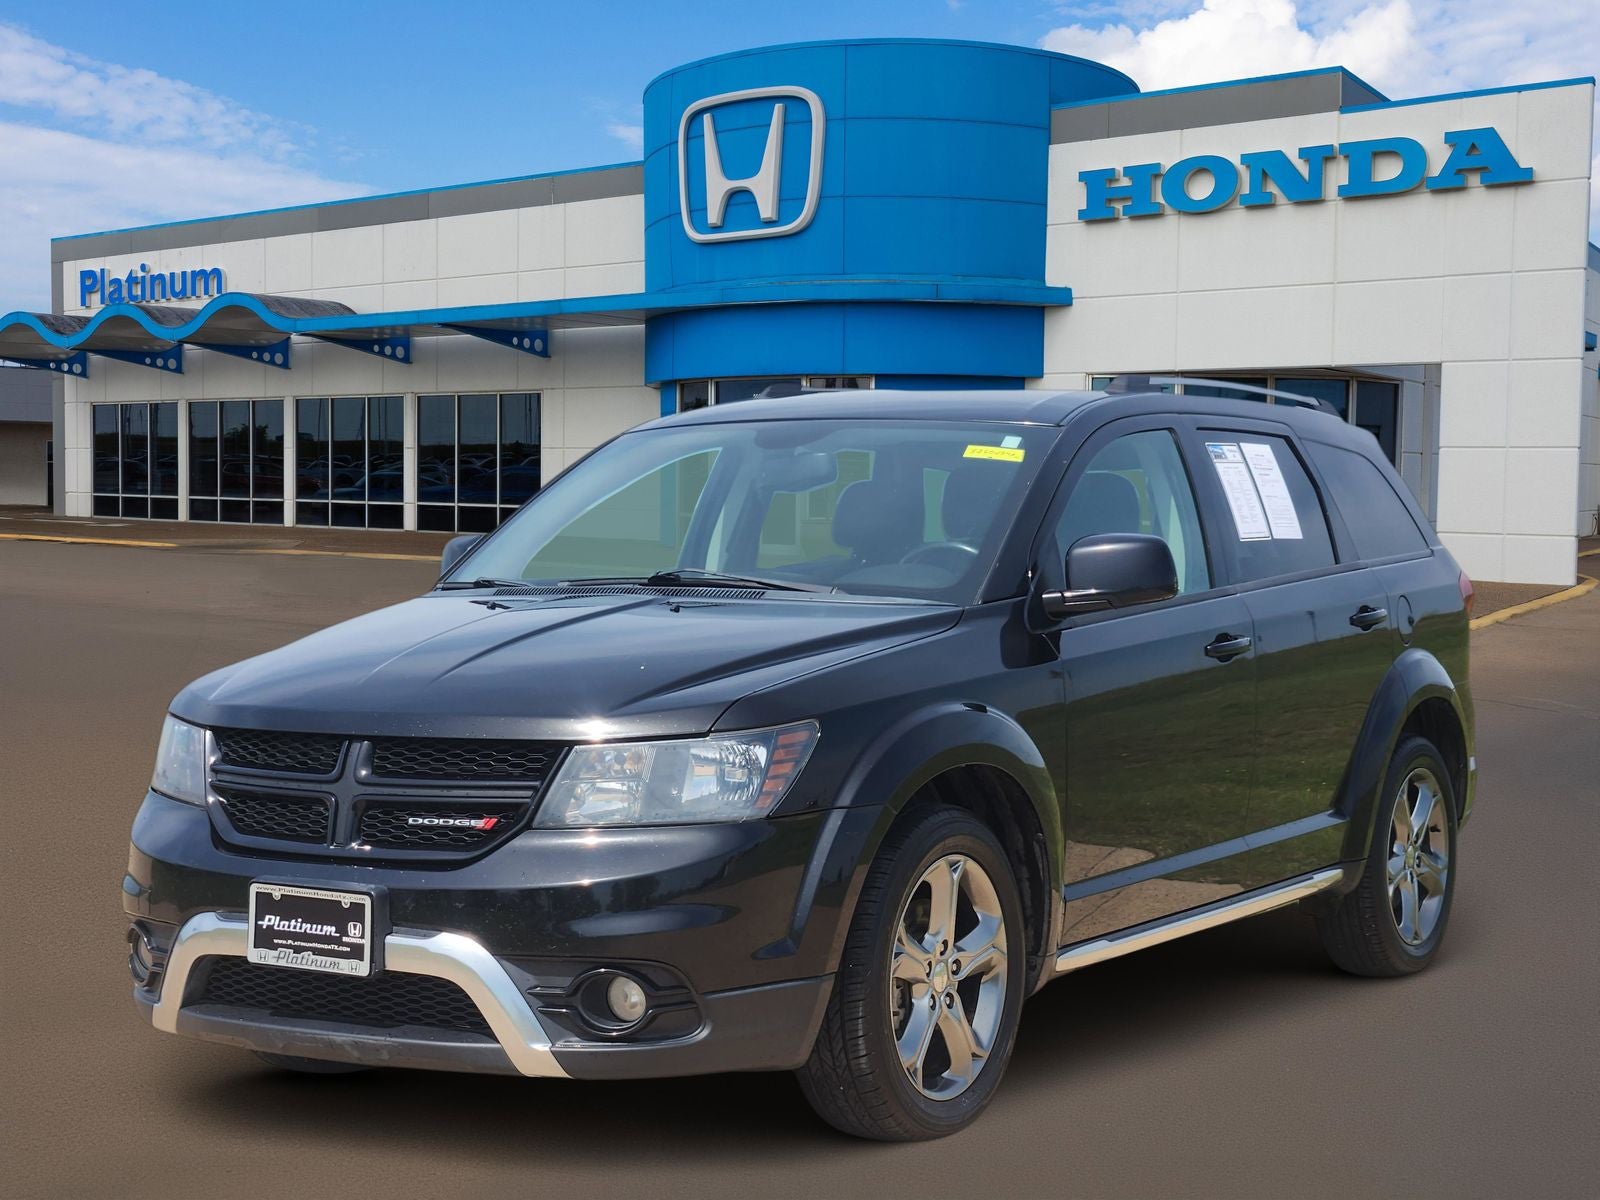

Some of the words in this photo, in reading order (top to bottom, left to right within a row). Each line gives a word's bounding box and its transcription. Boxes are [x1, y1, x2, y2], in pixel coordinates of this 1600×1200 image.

[1078, 127, 1534, 222] HONDA
[79, 263, 226, 307] Platinum
[408, 817, 485, 826] DODGE
[257, 914, 341, 937] Platinum
[272, 951, 344, 971] Platinum
